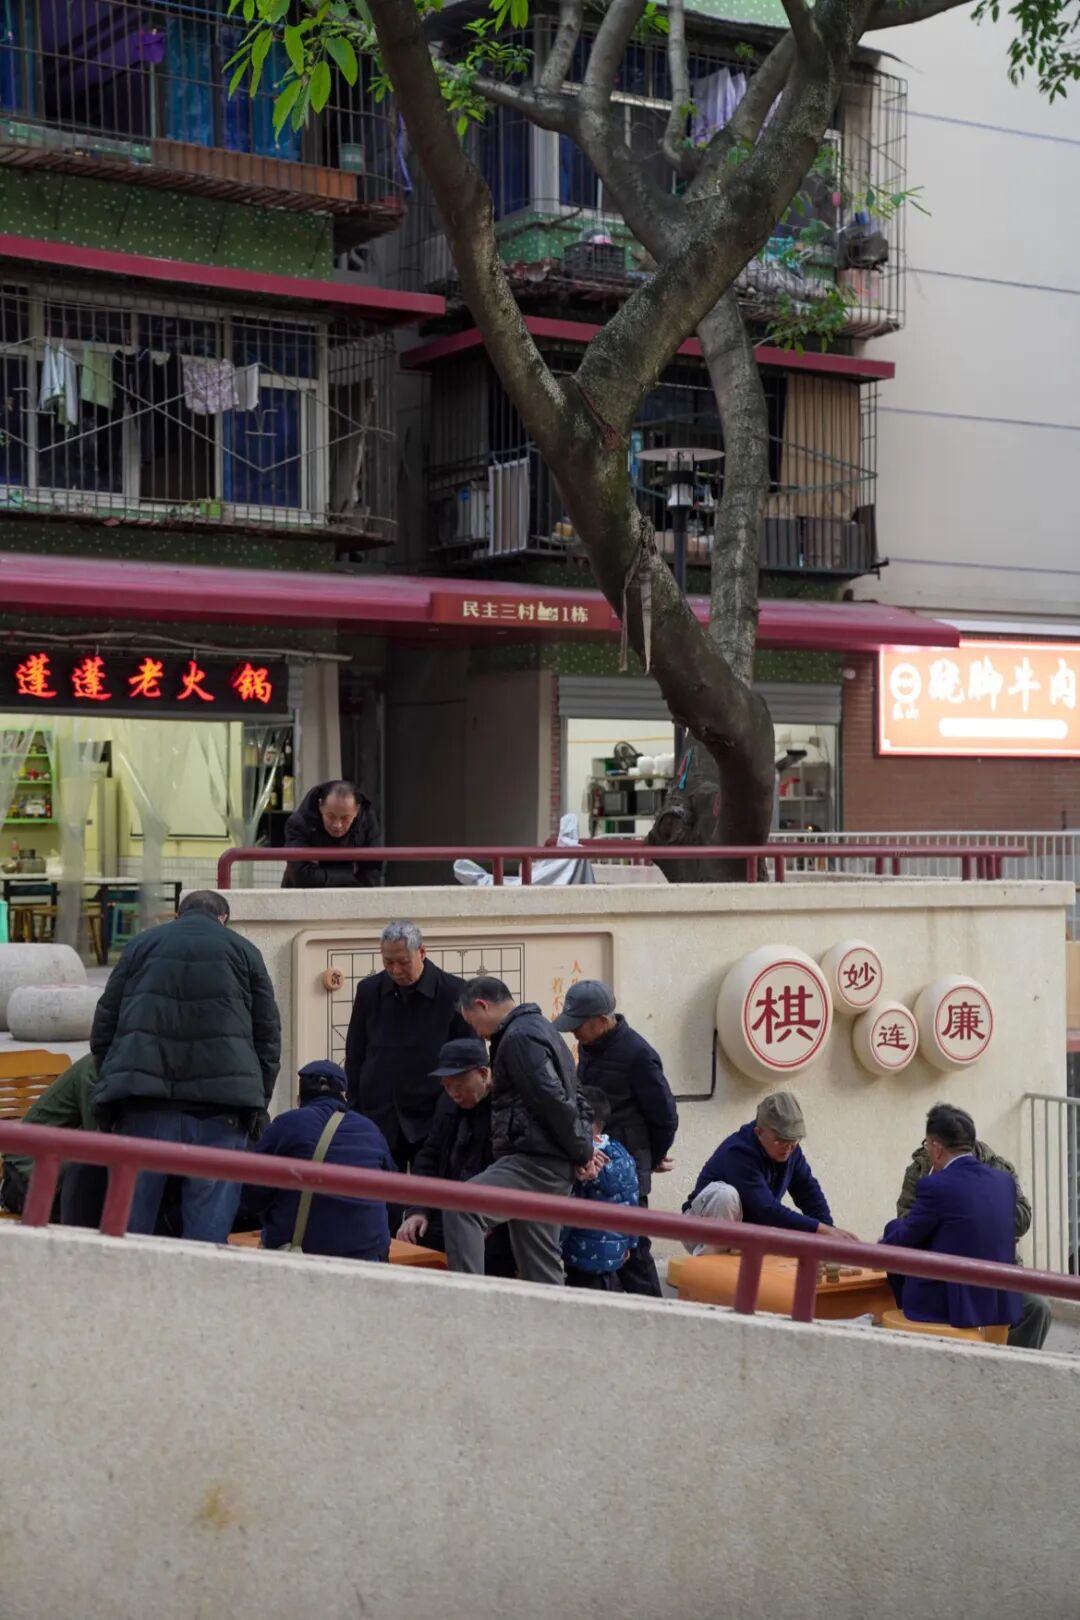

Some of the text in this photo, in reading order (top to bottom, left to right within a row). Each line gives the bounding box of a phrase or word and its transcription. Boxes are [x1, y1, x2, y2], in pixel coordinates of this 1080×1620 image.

[843, 962, 877, 990] 妙
[751, 985, 821, 1045] 棋
[941, 1001, 986, 1040] 廉
[877, 1023, 910, 1050] 连
